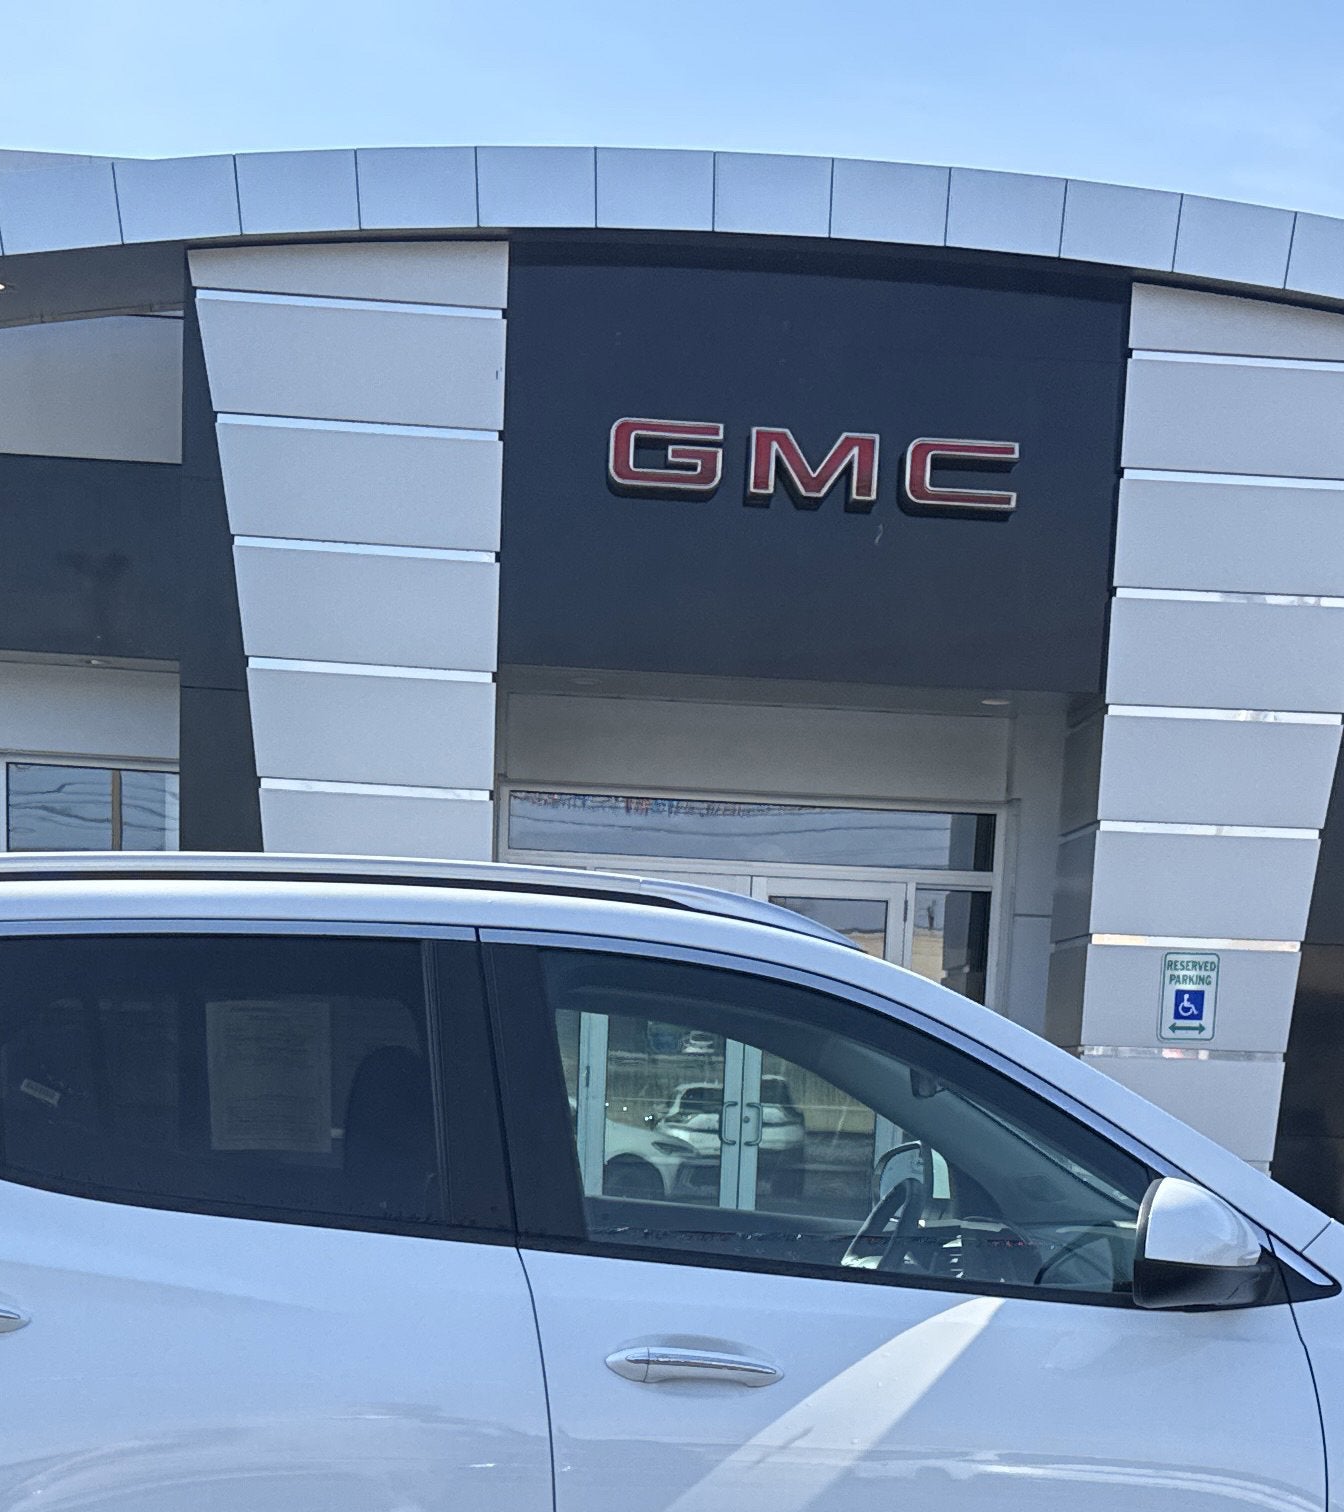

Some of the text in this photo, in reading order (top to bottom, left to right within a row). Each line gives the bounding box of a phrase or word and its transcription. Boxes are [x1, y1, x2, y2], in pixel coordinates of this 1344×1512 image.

[609, 416, 1021, 512] GMC
[1167, 960, 1216, 971] RESERVED
[1169, 974, 1212, 985] PARKING
